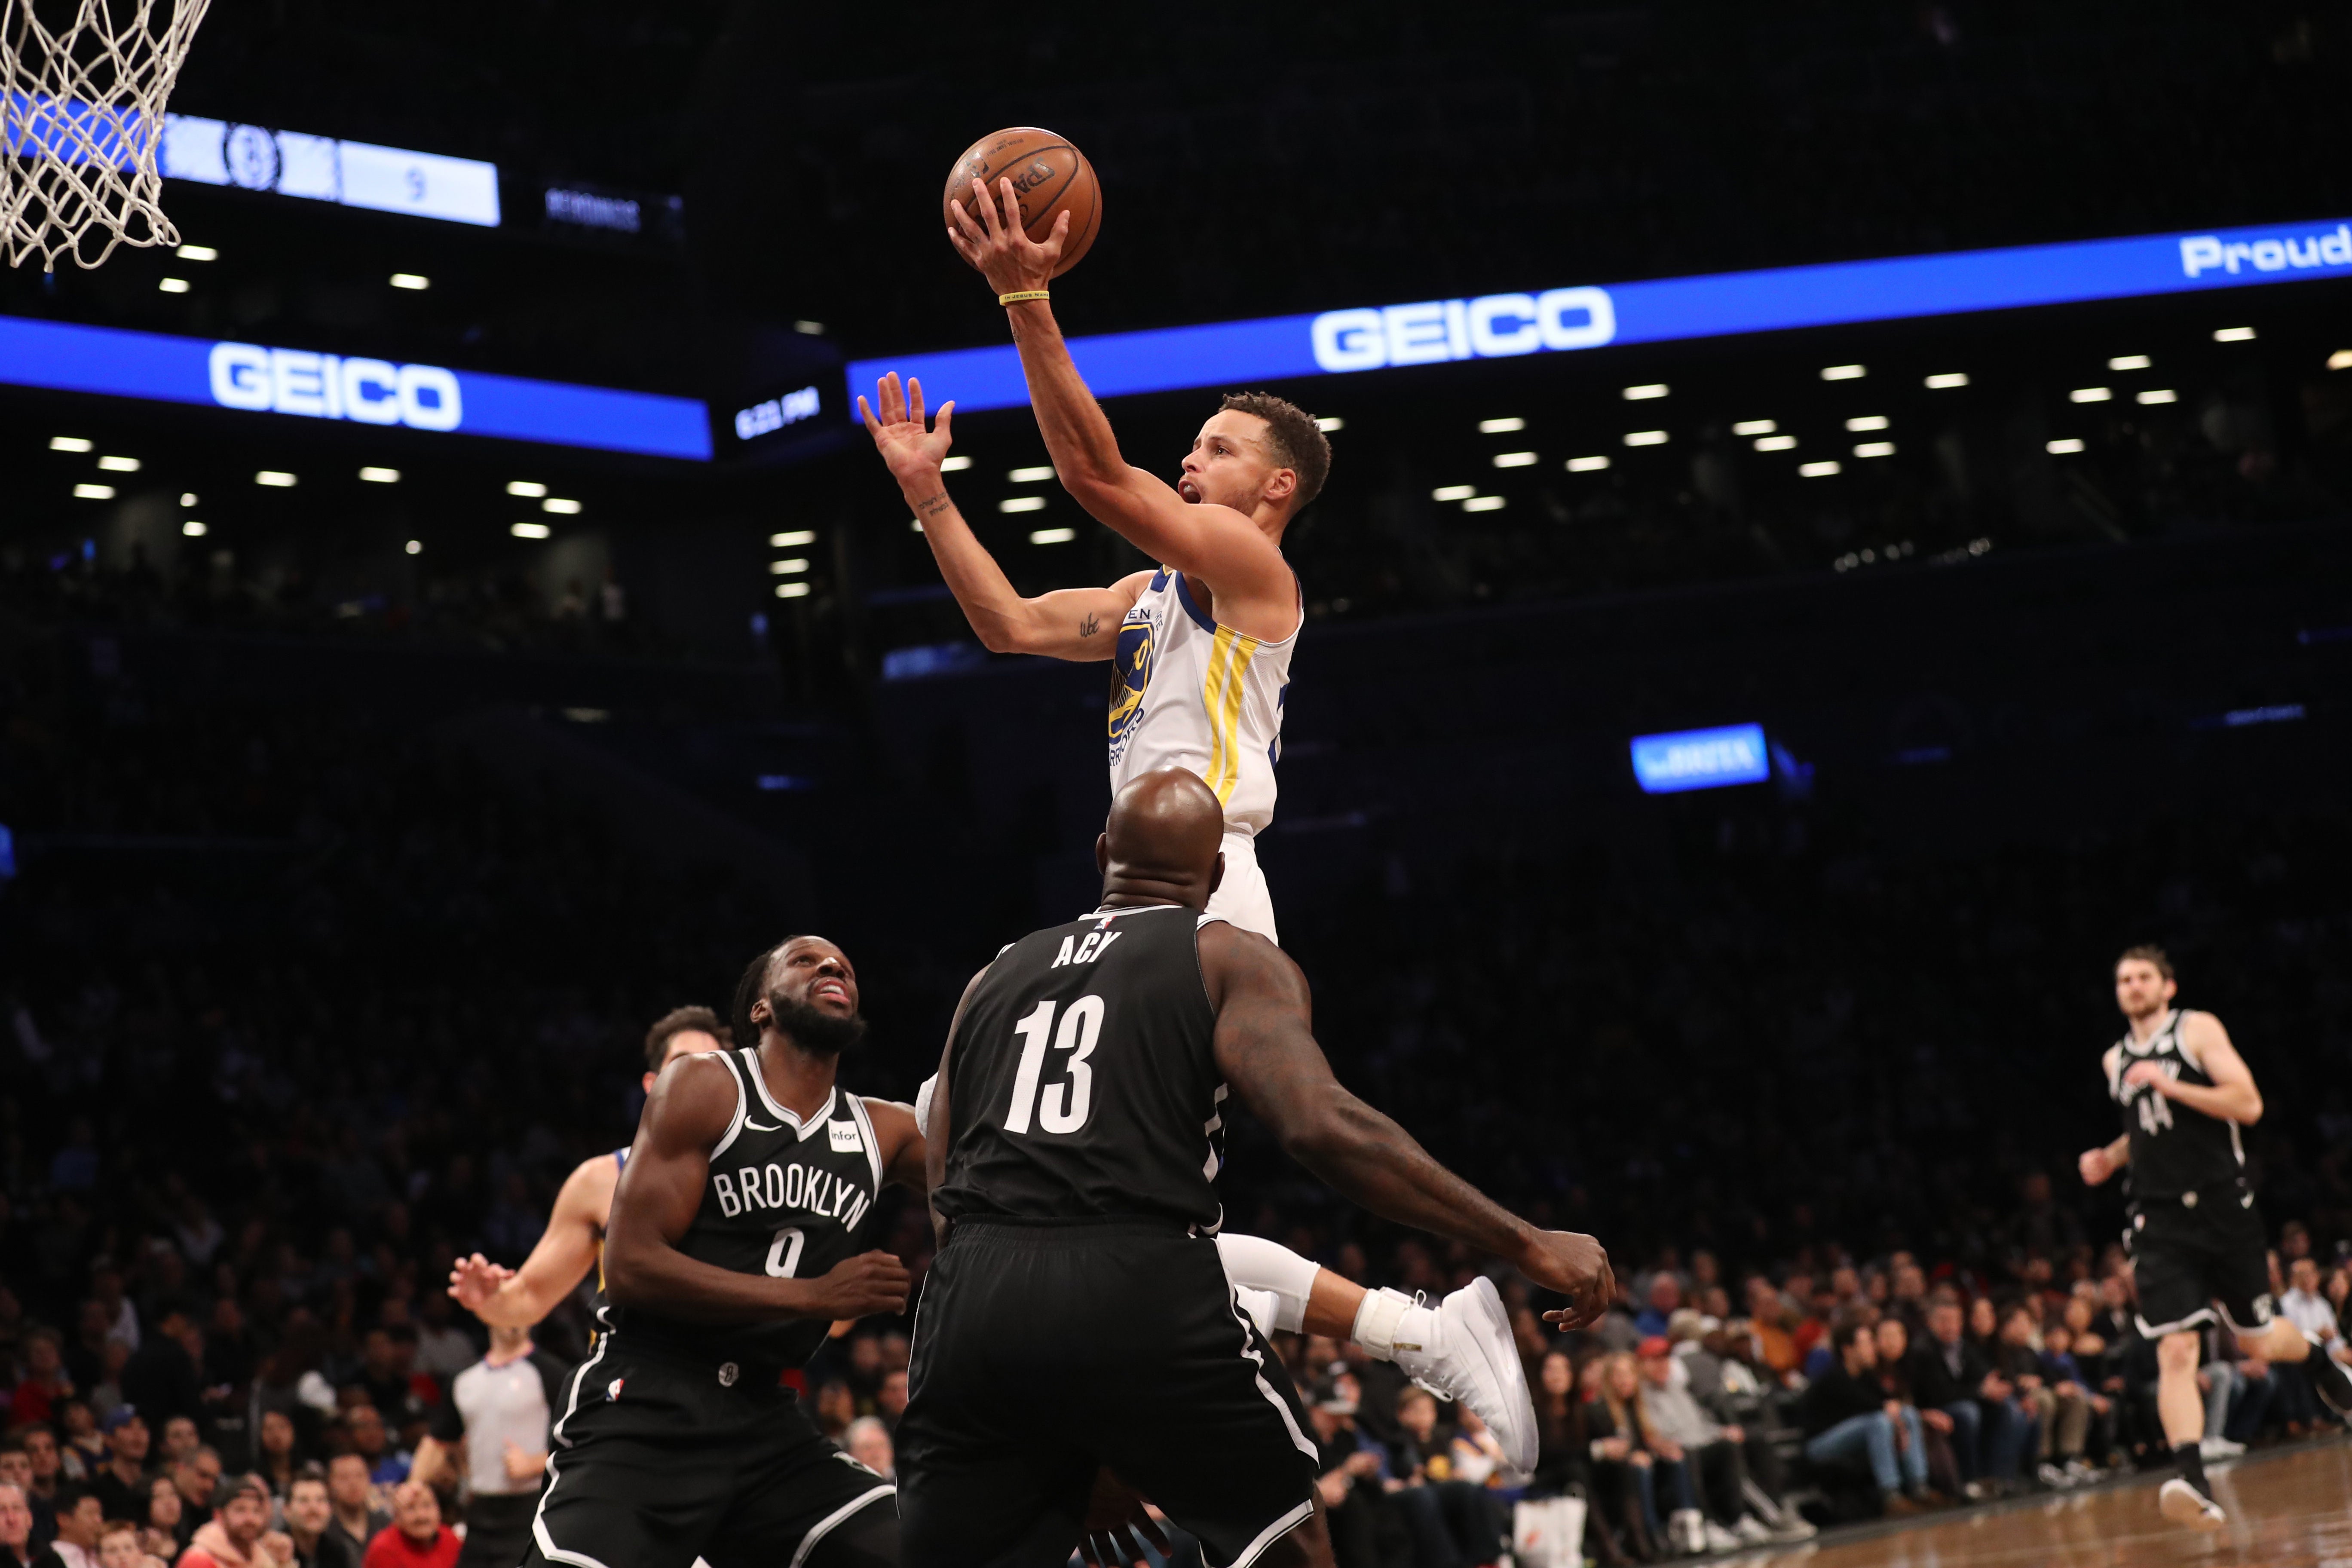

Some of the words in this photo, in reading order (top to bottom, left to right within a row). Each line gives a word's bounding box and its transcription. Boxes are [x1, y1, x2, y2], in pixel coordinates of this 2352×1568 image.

[2179, 224, 2352, 279] Proud
[1311, 285, 1616, 373] GEICO
[208, 341, 462, 432] GEICO
[1050, 931, 1122, 969] ACY
[1003, 995, 1105, 1134] 13
[831, 1129, 856, 1140] infor
[2138, 1090, 2174, 1137] 44
[714, 1163, 870, 1233] BROOKLYN
